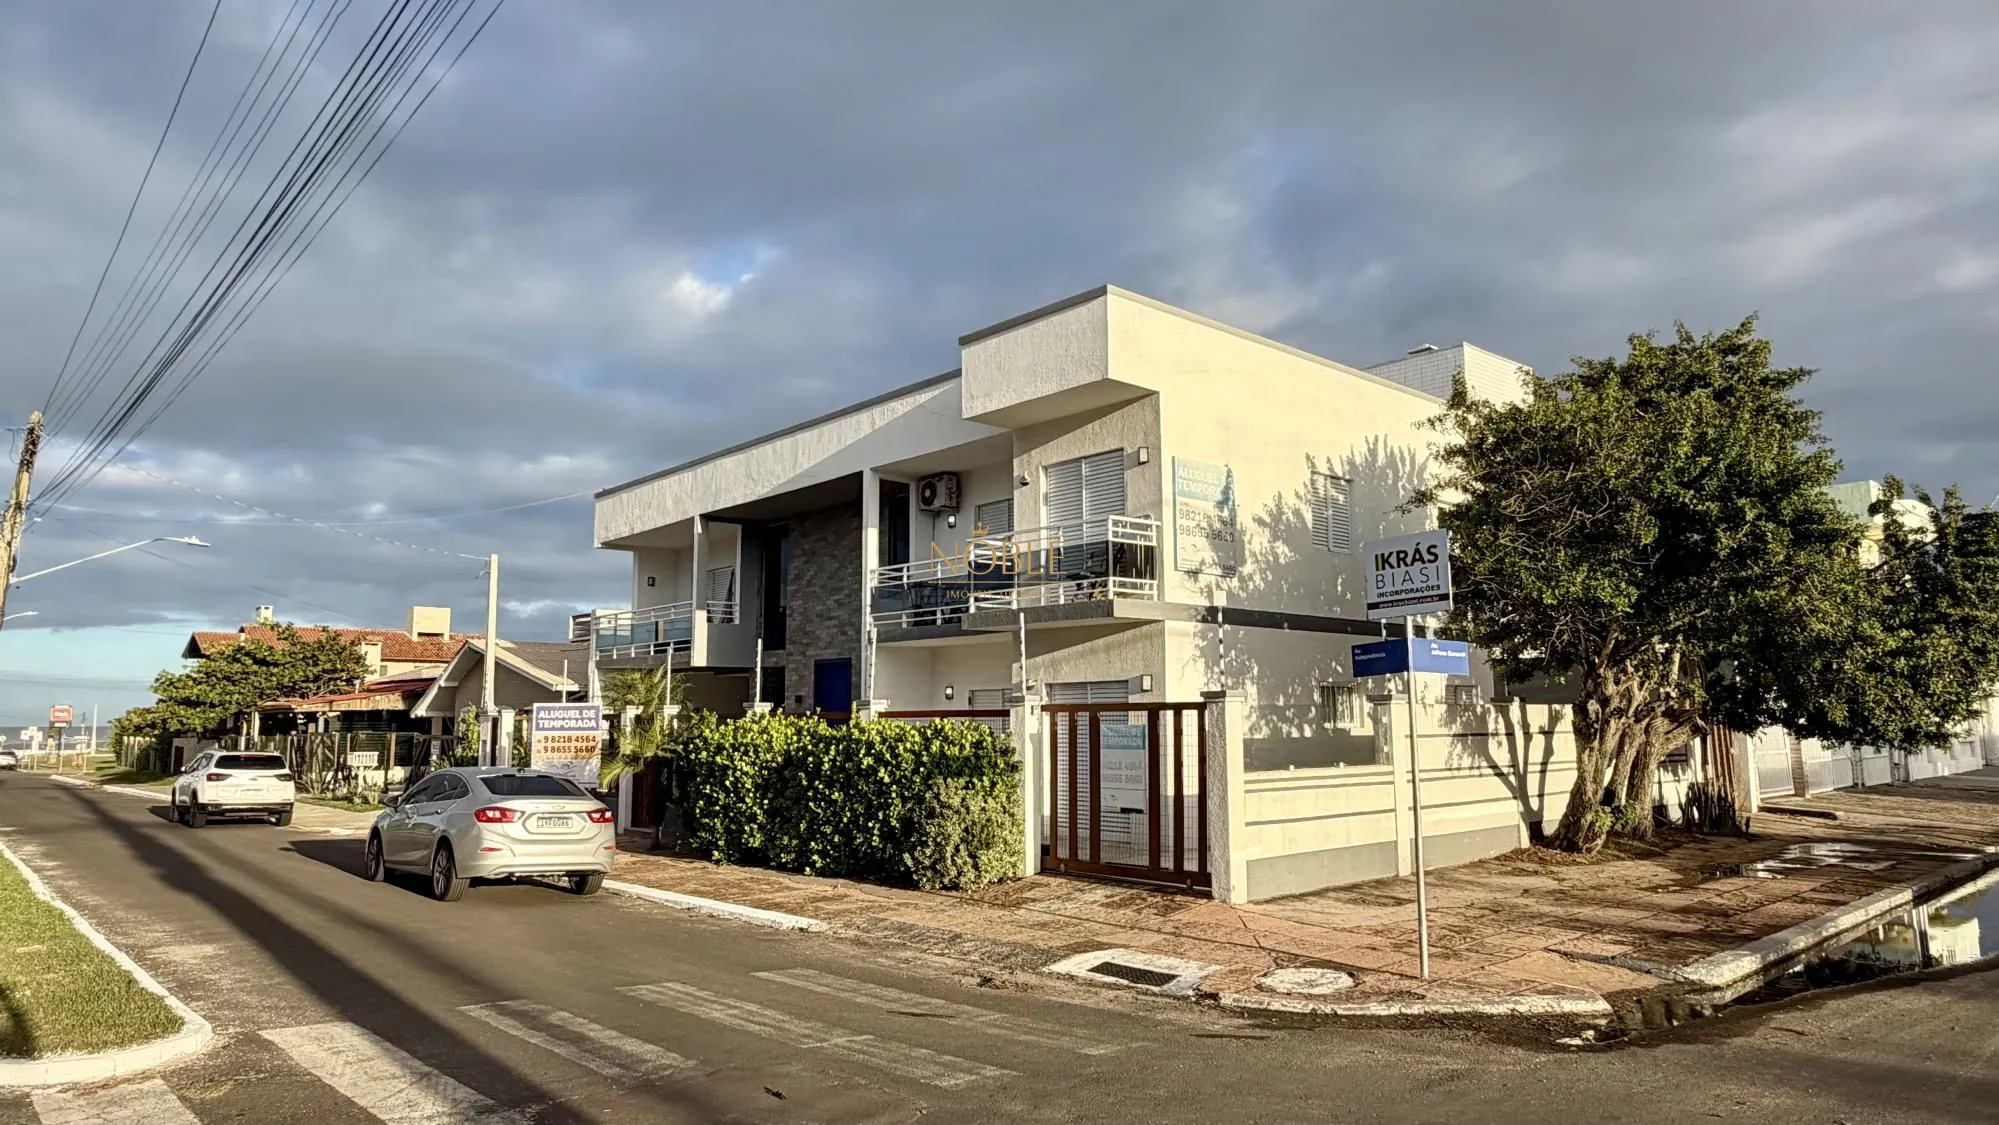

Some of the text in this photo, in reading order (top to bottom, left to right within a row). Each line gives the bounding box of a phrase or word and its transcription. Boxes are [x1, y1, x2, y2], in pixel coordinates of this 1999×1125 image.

[1375, 565, 1441, 590] BIASI
[1376, 584, 1441, 599] INCORPORAÇÕES
[538, 709, 596, 719] ALUGUEL DE
[538, 719, 597, 728] TEMPORADA
[543, 735, 549, 743] 9
[550, 735, 573, 744] 8218
[573, 735, 597, 743] 4564
[543, 745, 549, 753] 9
[550, 745, 573, 753] 8655
[573, 745, 596, 754] 5660
